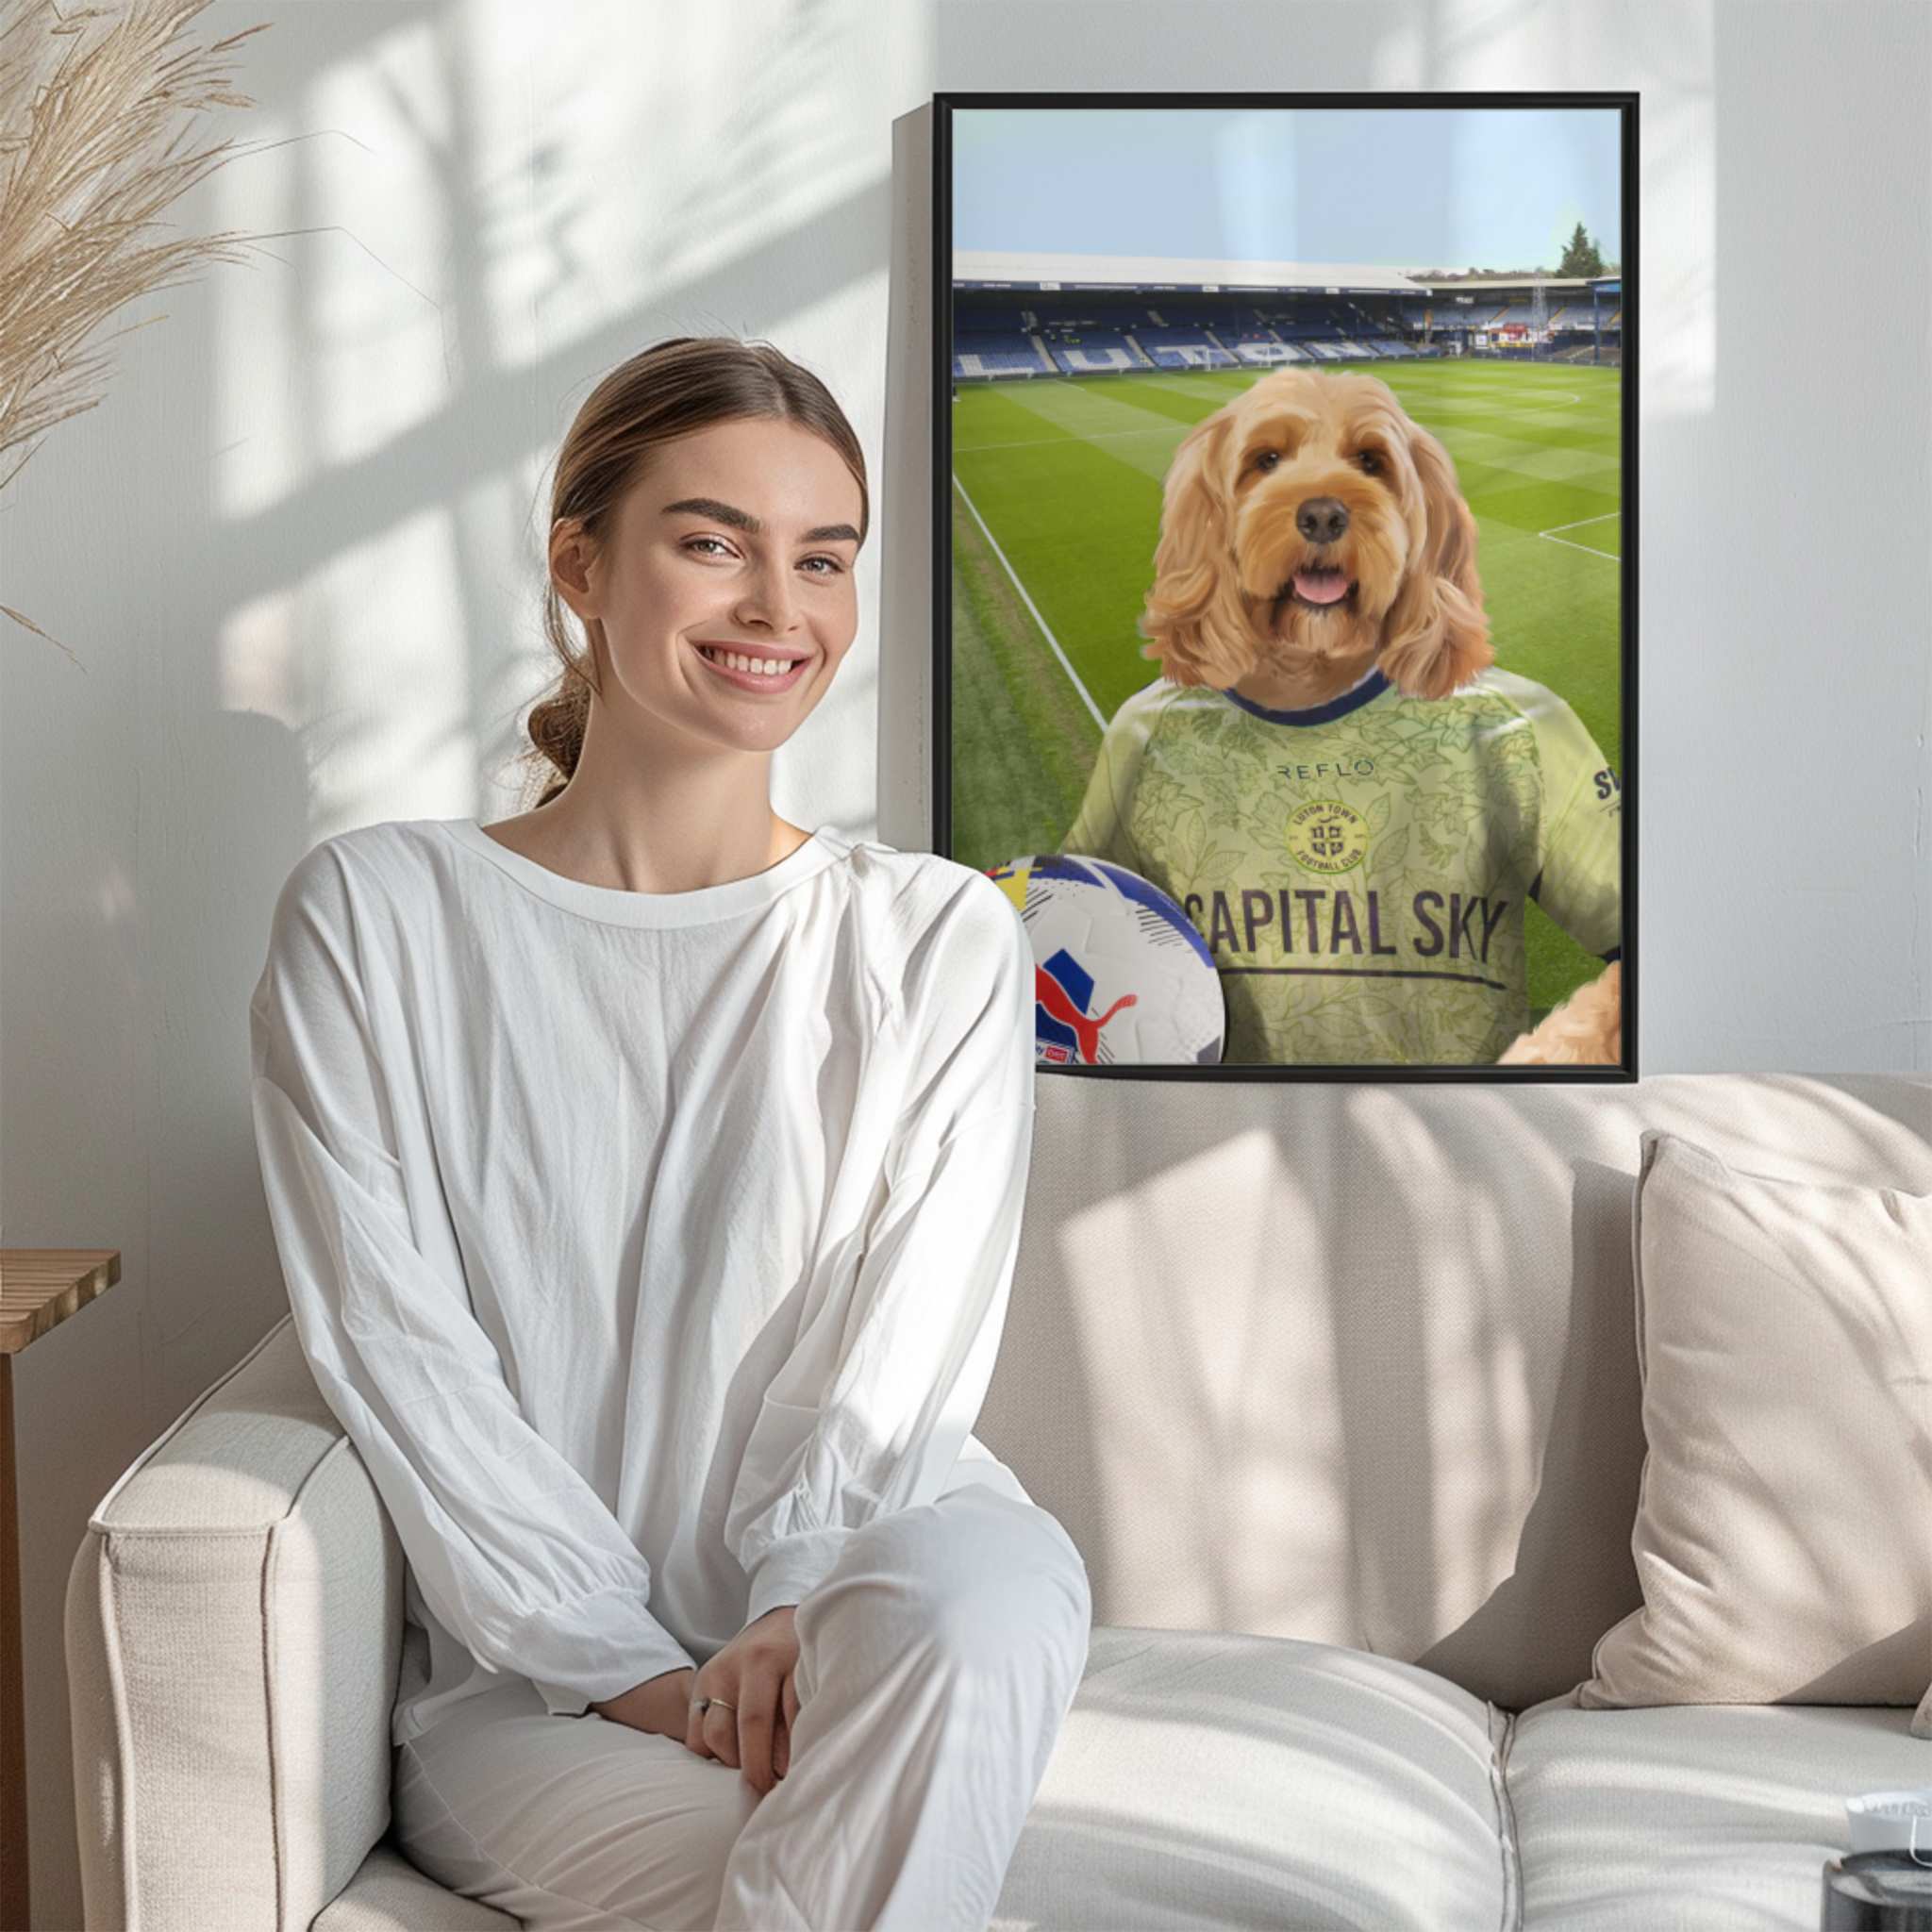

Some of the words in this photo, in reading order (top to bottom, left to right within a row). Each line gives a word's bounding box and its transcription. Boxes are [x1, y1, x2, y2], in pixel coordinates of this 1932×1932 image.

[958, 341, 1370, 376] LUTON
[1276, 759, 1374, 779] REFLO
[1292, 805, 1324, 825] LUTON
[1328, 804, 1358, 824] TOWN
[1295, 850, 1340, 871] FOOTBALL
[1341, 848, 1362, 867] CLUB
[1413, 890, 1508, 963] SKY
